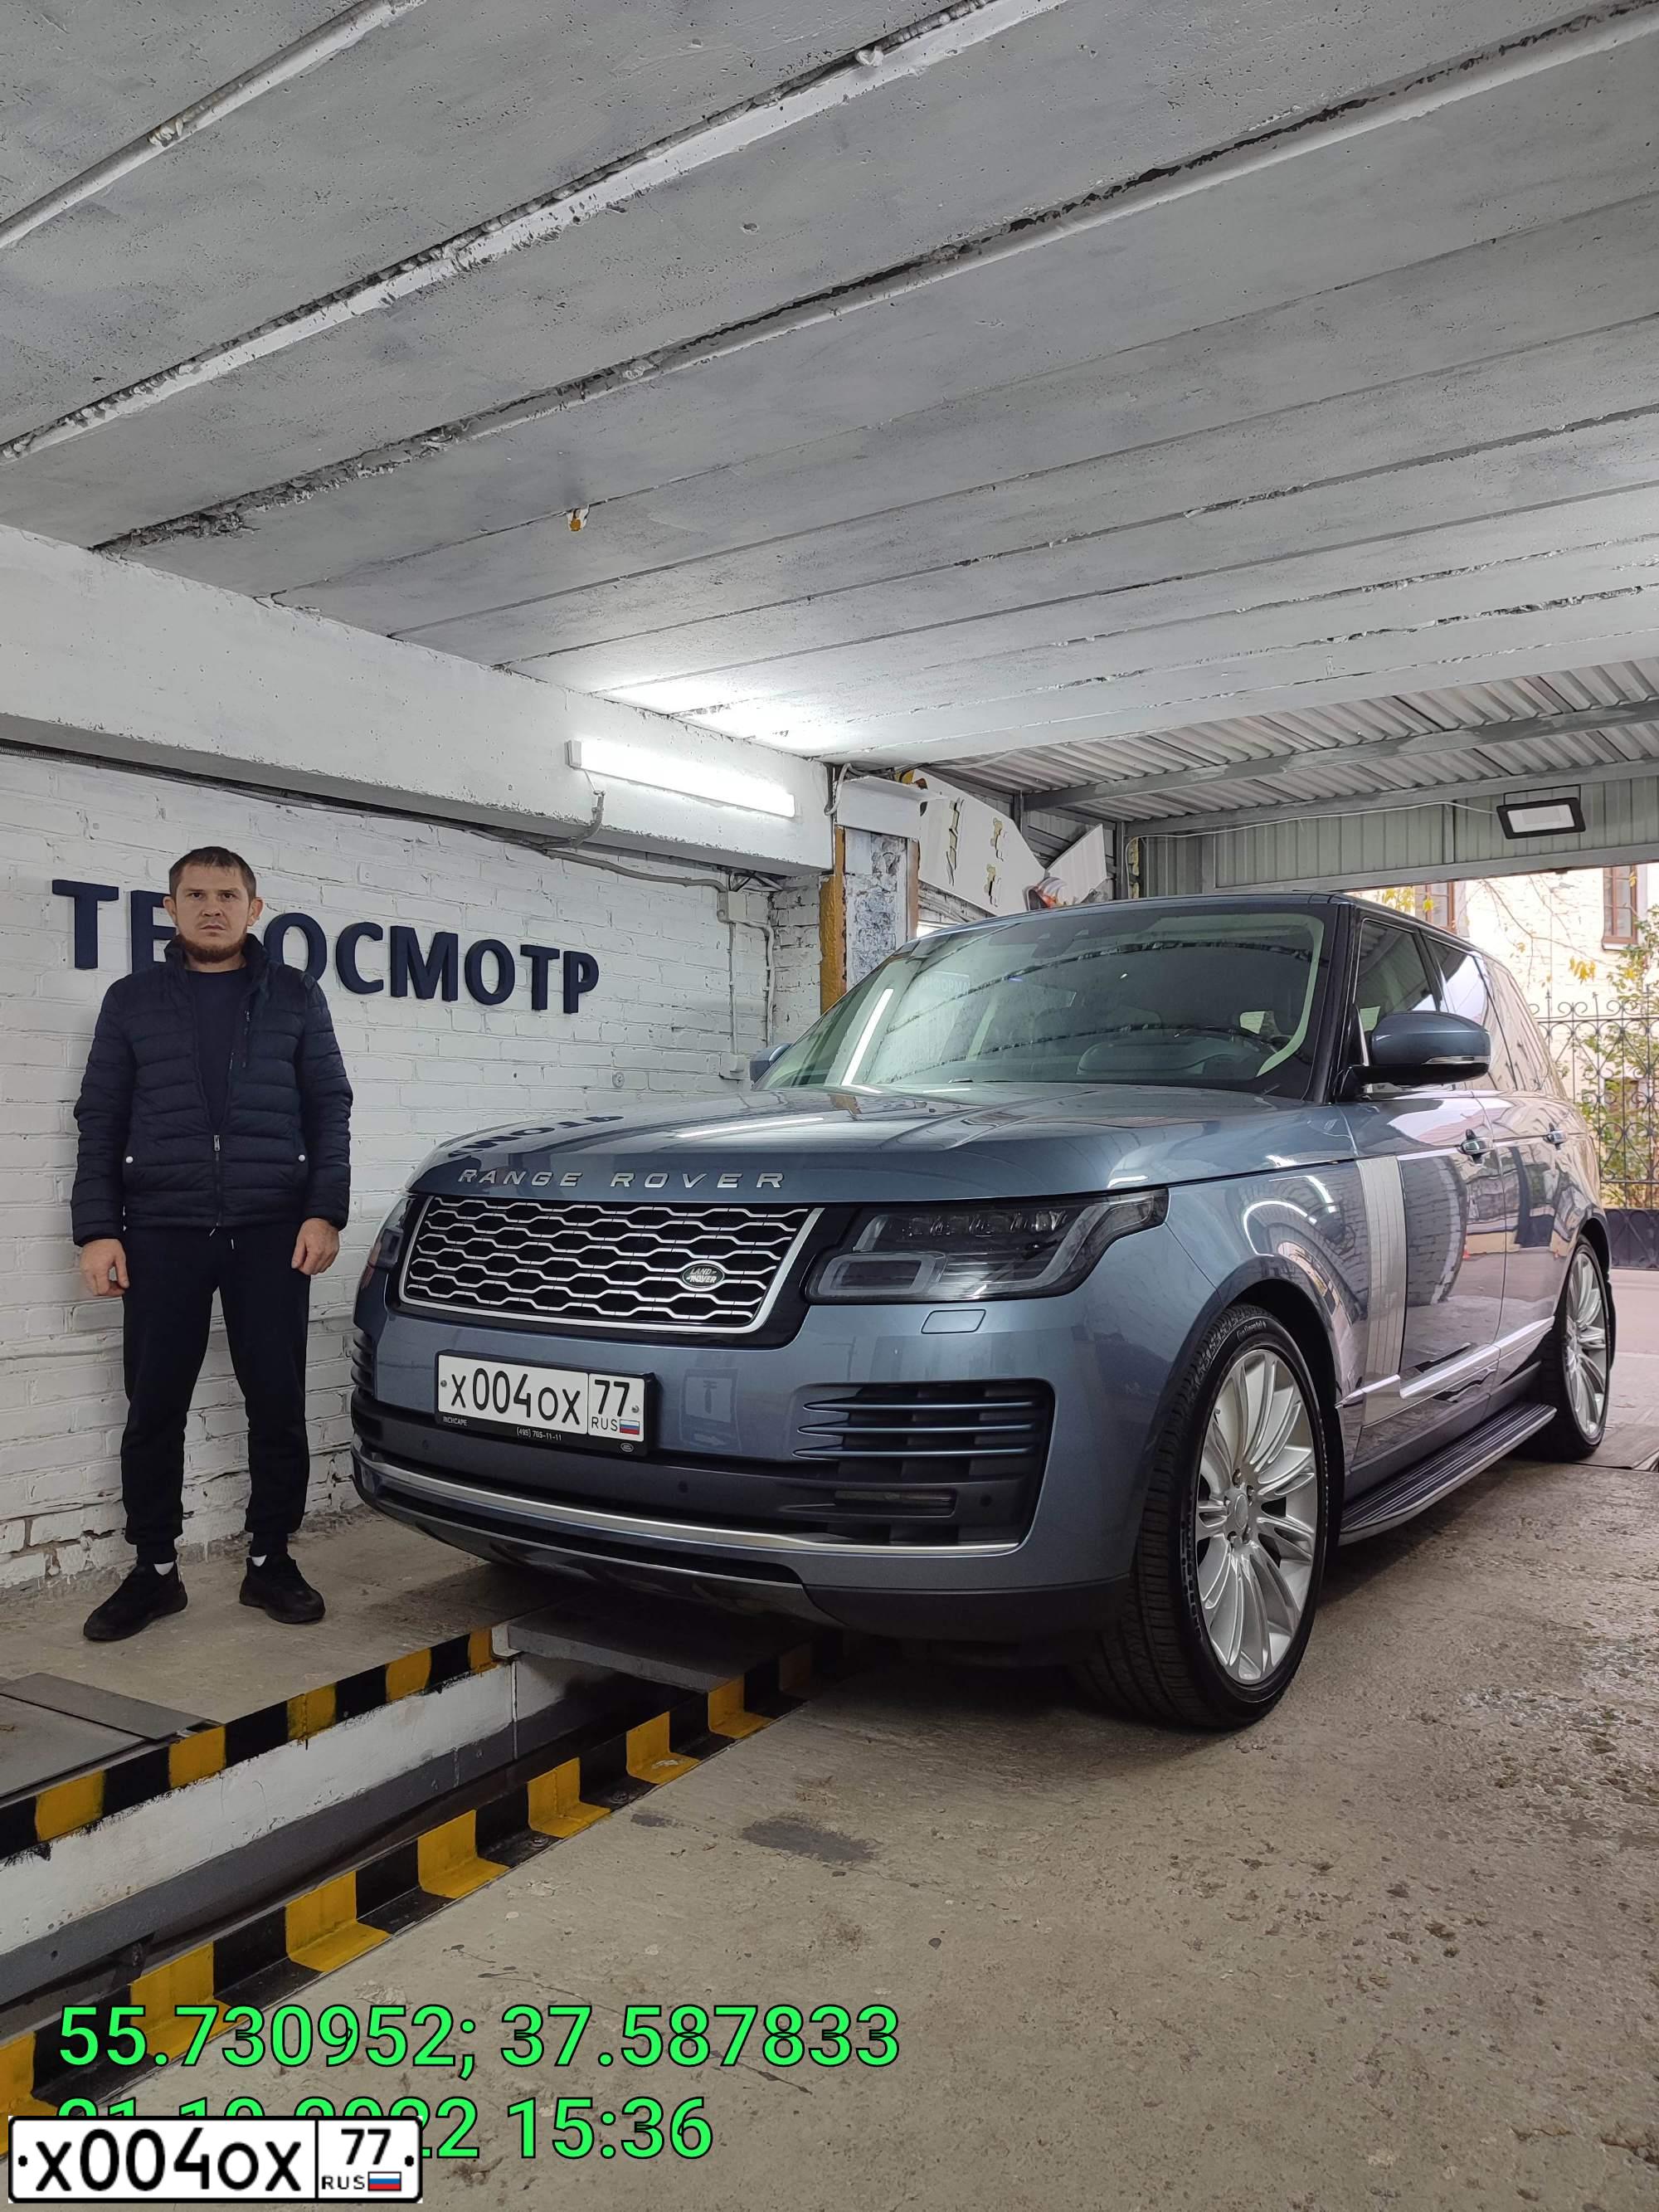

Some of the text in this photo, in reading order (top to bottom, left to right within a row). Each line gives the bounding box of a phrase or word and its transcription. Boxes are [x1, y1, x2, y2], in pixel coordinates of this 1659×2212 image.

[51, 879, 600, 1014] ТЕОСМОТР
[458, 1169, 784, 1188] RANGE ROVER
[594, 1379, 630, 1417] 77
[591, 1417, 618, 1432] RUS
